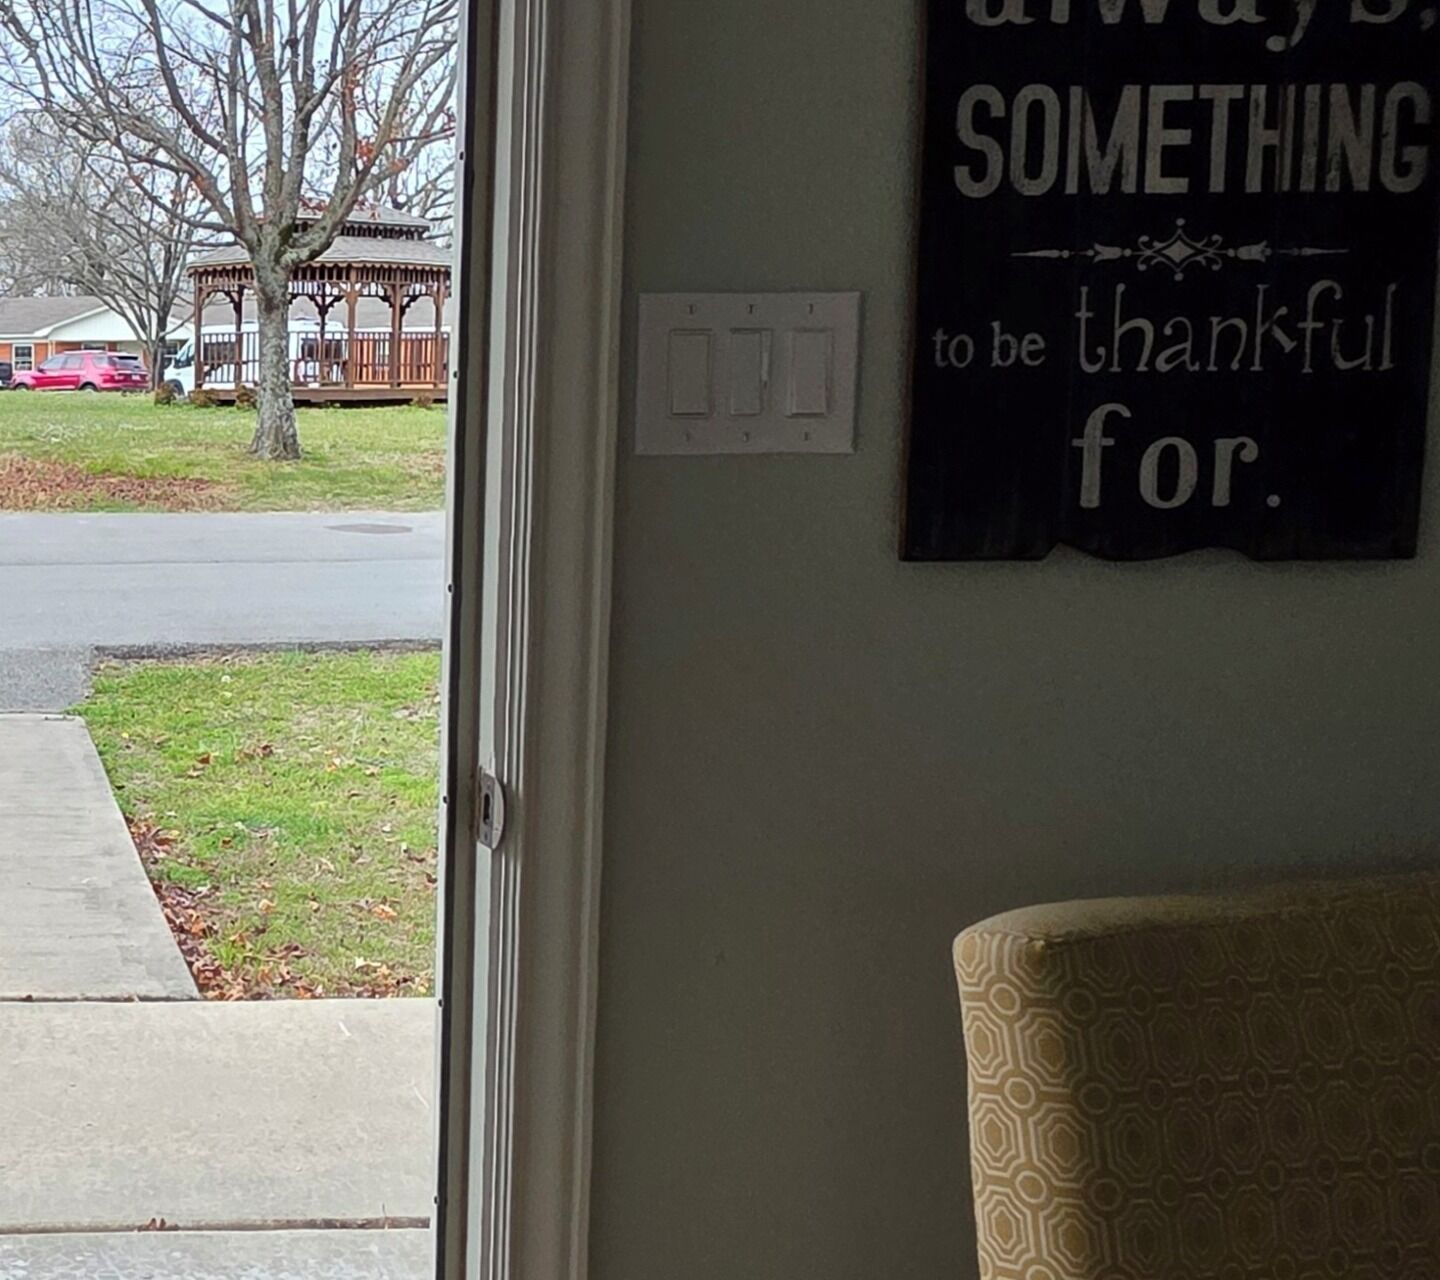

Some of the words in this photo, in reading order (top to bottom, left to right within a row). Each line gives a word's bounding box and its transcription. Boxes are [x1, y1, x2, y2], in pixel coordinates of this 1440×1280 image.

[953, 80, 1431, 198] SOMETHING
[932, 328, 975, 368] to
[990, 320, 1047, 367] be
[1074, 279, 1397, 374] thankful
[1071, 402, 1281, 509] for.
